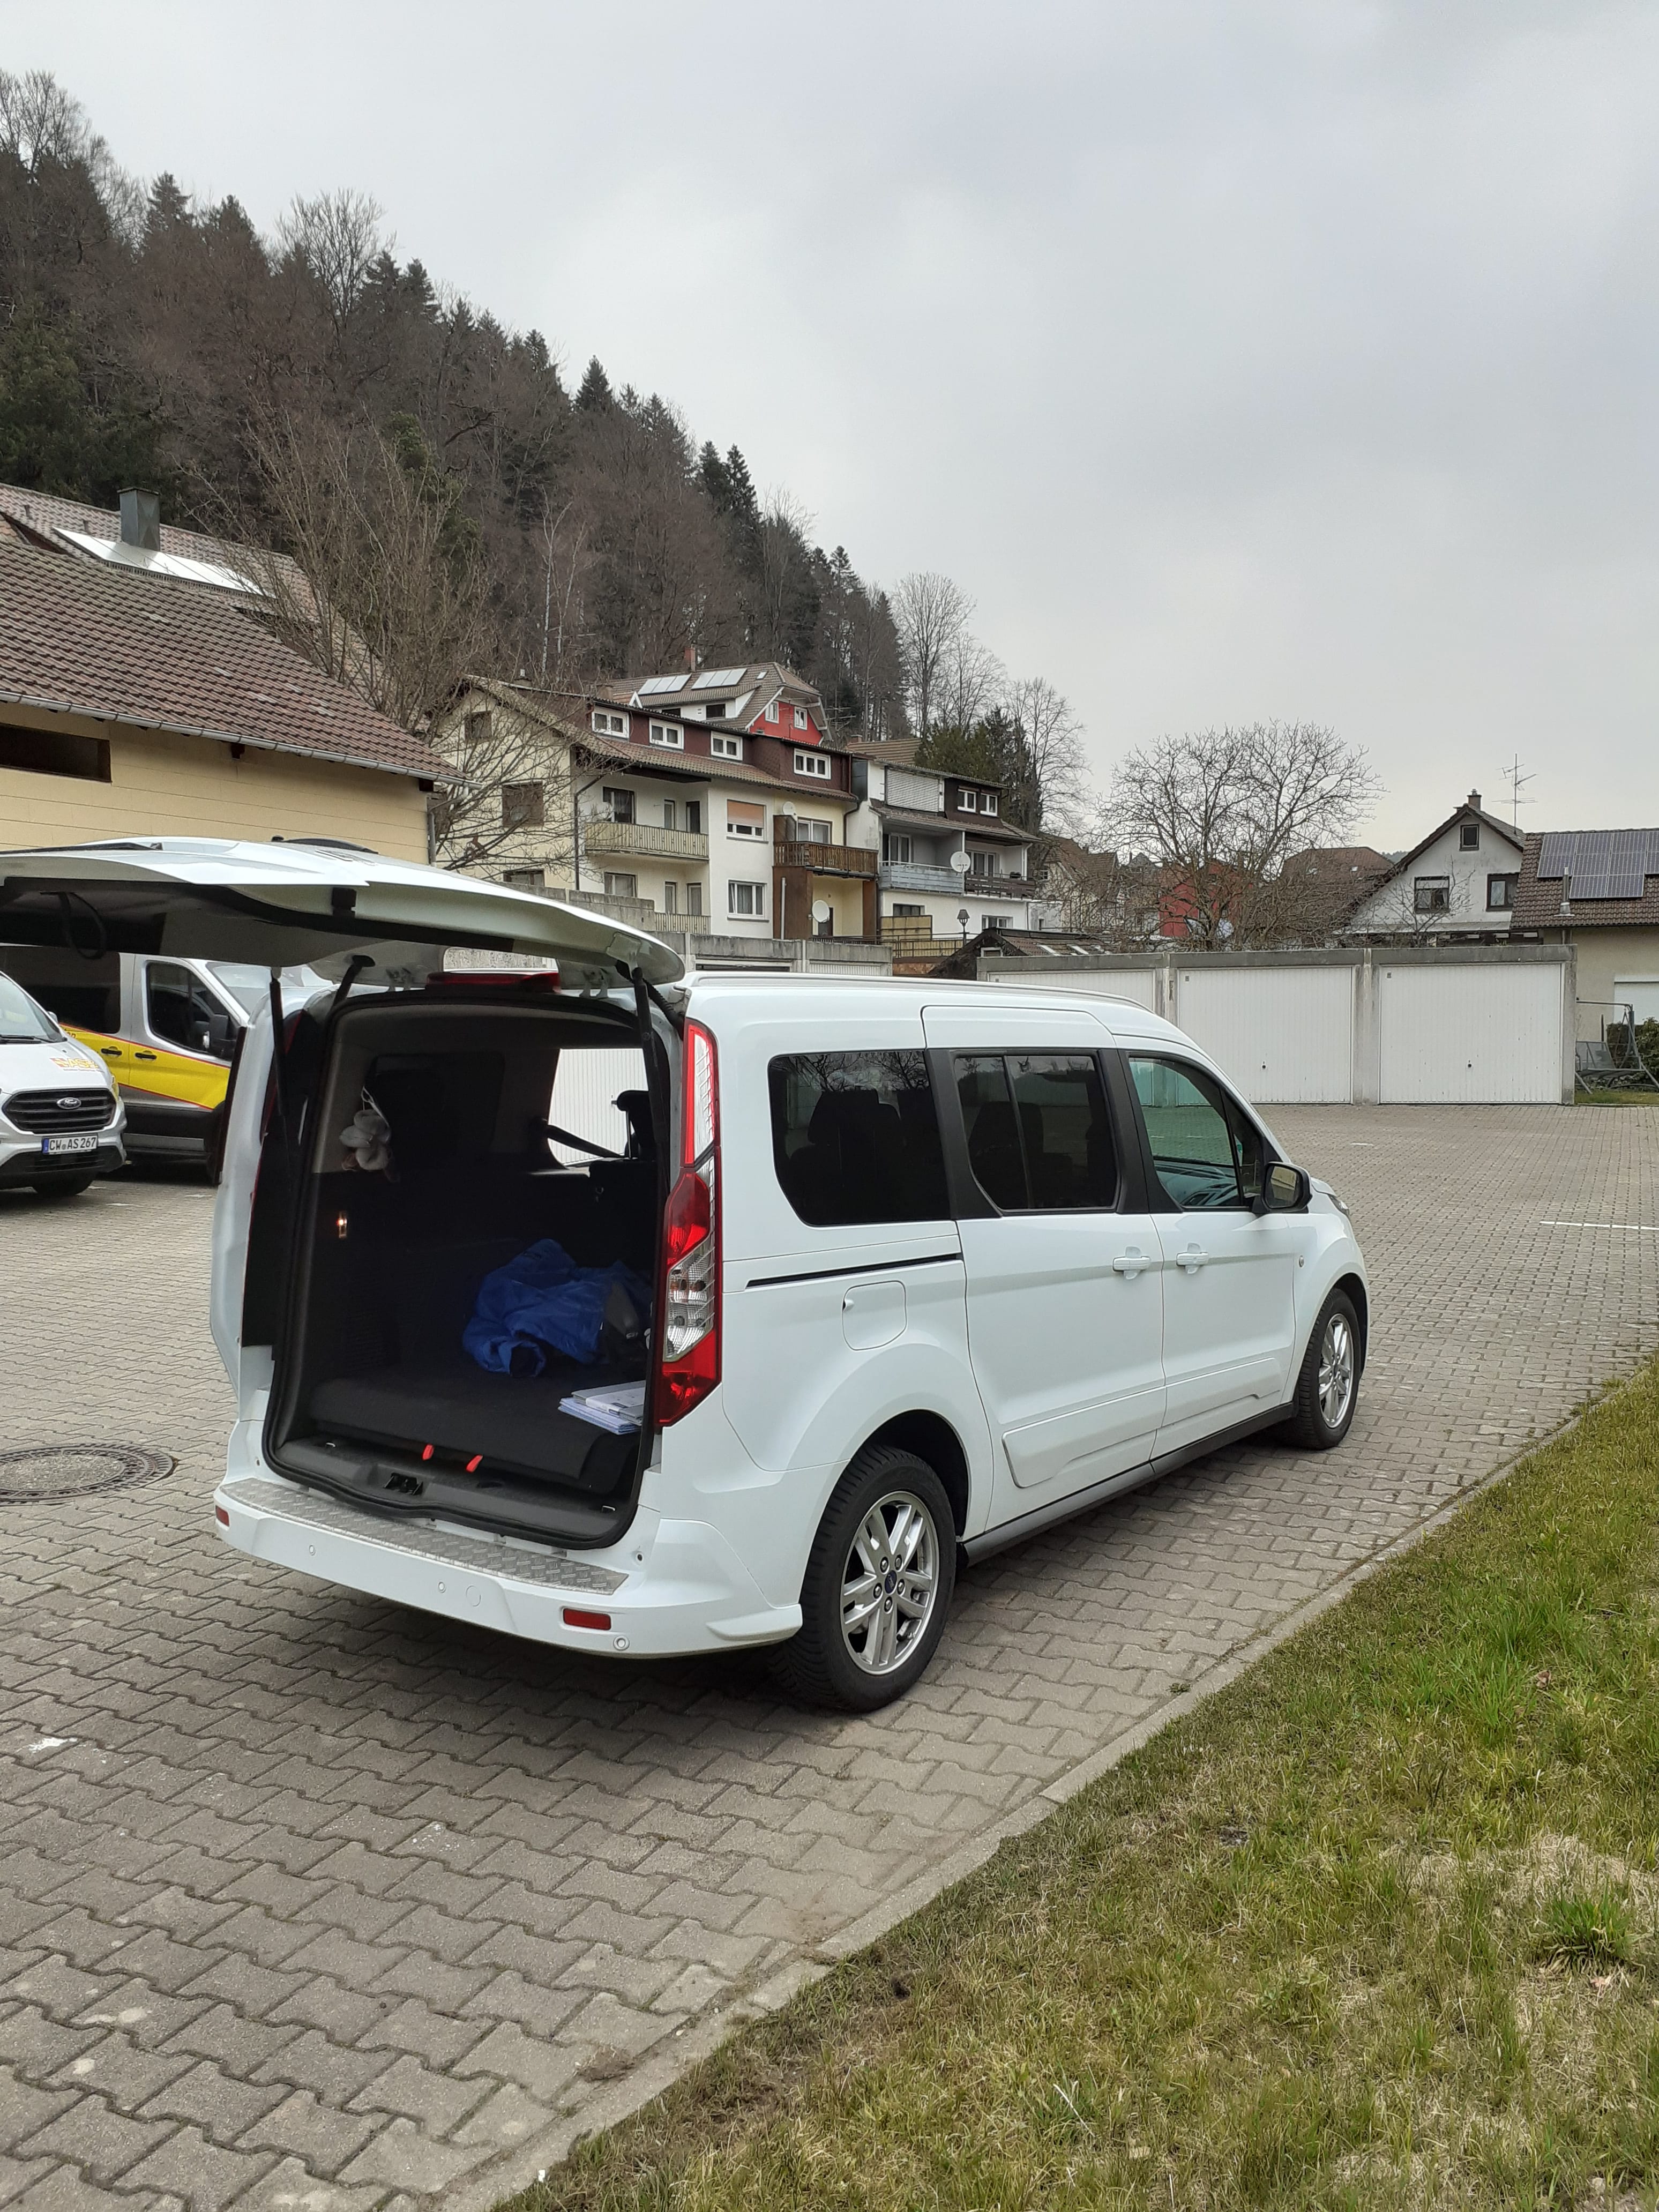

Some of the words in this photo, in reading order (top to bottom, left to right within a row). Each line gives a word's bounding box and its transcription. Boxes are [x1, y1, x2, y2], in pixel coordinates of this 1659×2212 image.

[50, 1140, 62, 1150] CW
[67, 1139, 79, 1149] AS
[80, 1137, 96, 1148] 267
